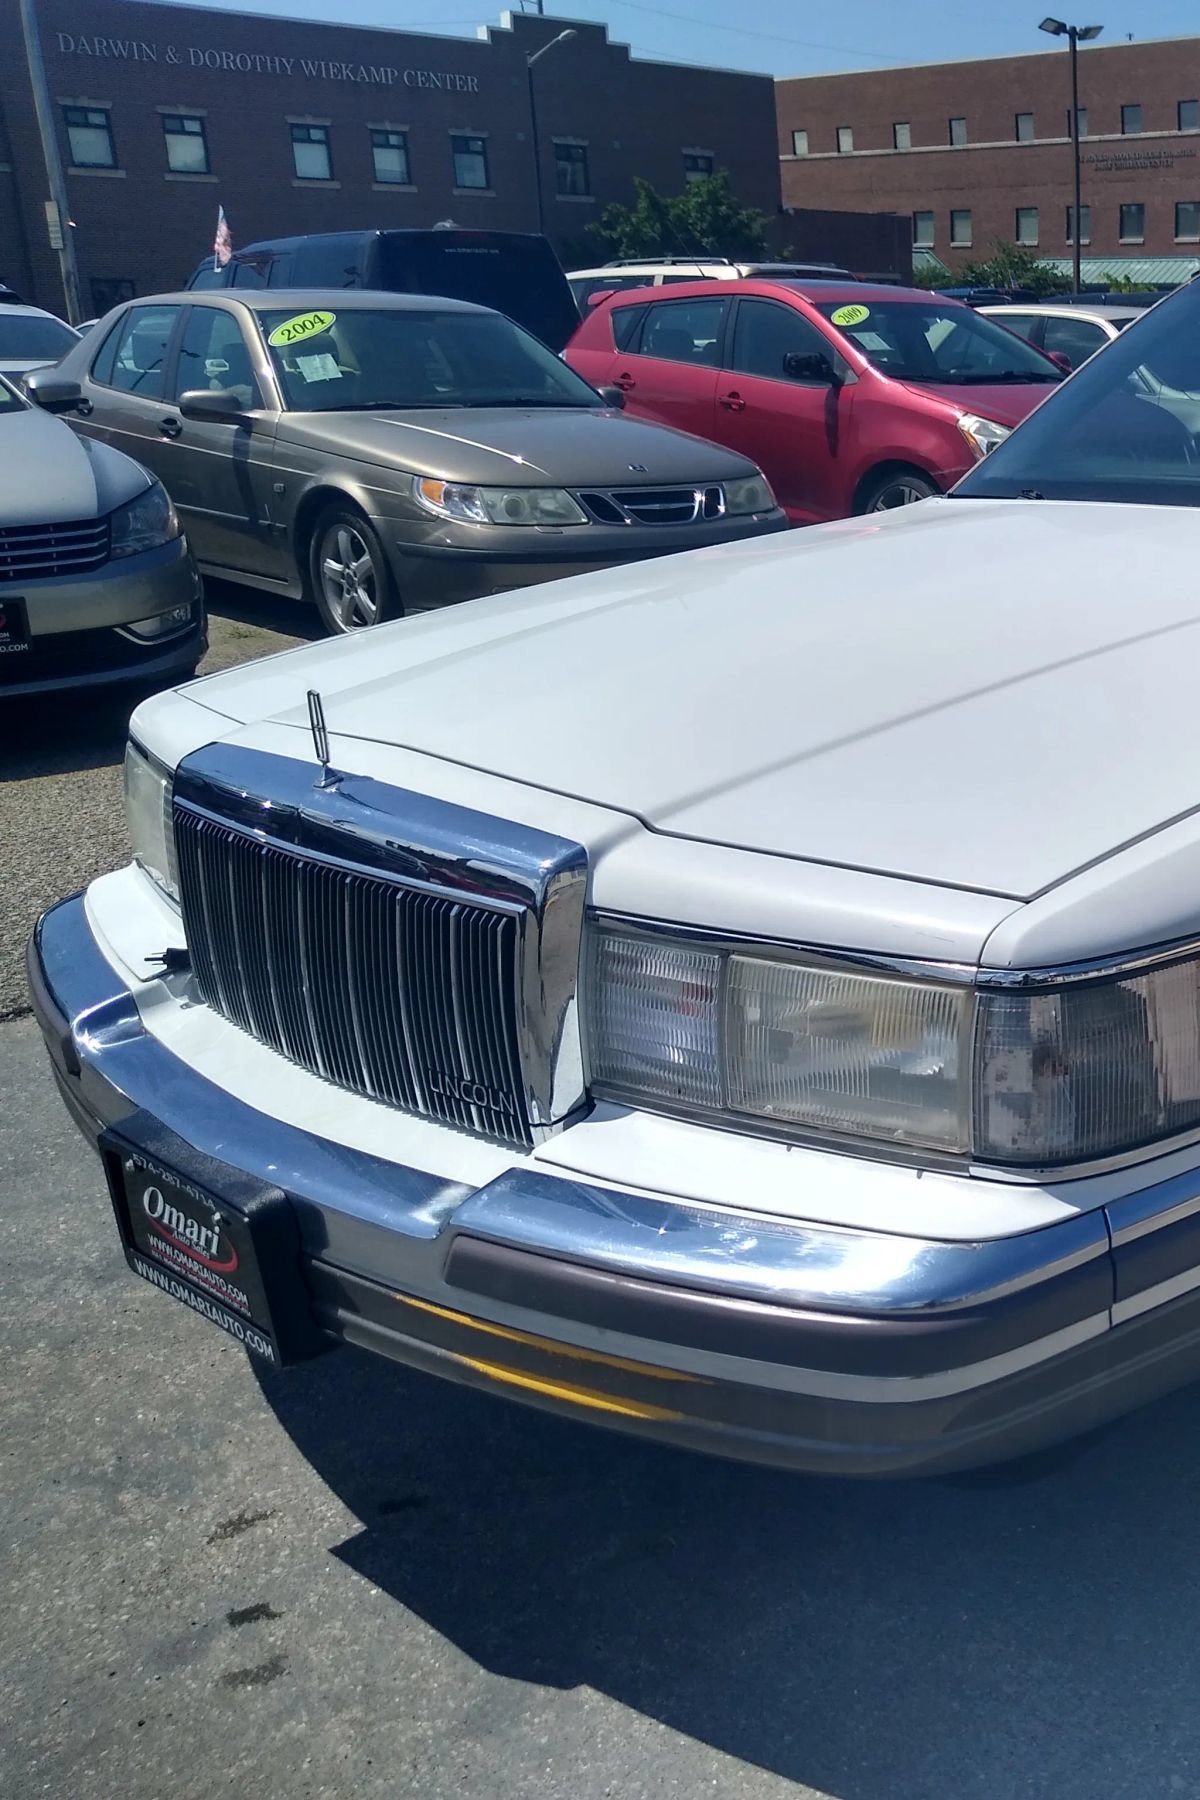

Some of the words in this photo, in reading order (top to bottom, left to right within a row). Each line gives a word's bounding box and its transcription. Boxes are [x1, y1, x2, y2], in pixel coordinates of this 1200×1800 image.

[56, 32, 158, 62] DARWIN
[165, 45, 181, 64] &
[189, 48, 295, 75] DOROTHY
[300, 60, 398, 85] WIEKAMP
[403, 70, 479, 93] CENTER
[281, 314, 326, 341] 2004
[838, 307, 862, 323] 2009
[428, 1069, 516, 1116] LINCOLN
[143, 1186, 220, 1256] Omari
[147, 1232, 249, 1306] WWW.OMARIAUTO.COM
[134, 1258, 276, 1362] WWW.OMARIAUTO.COM
